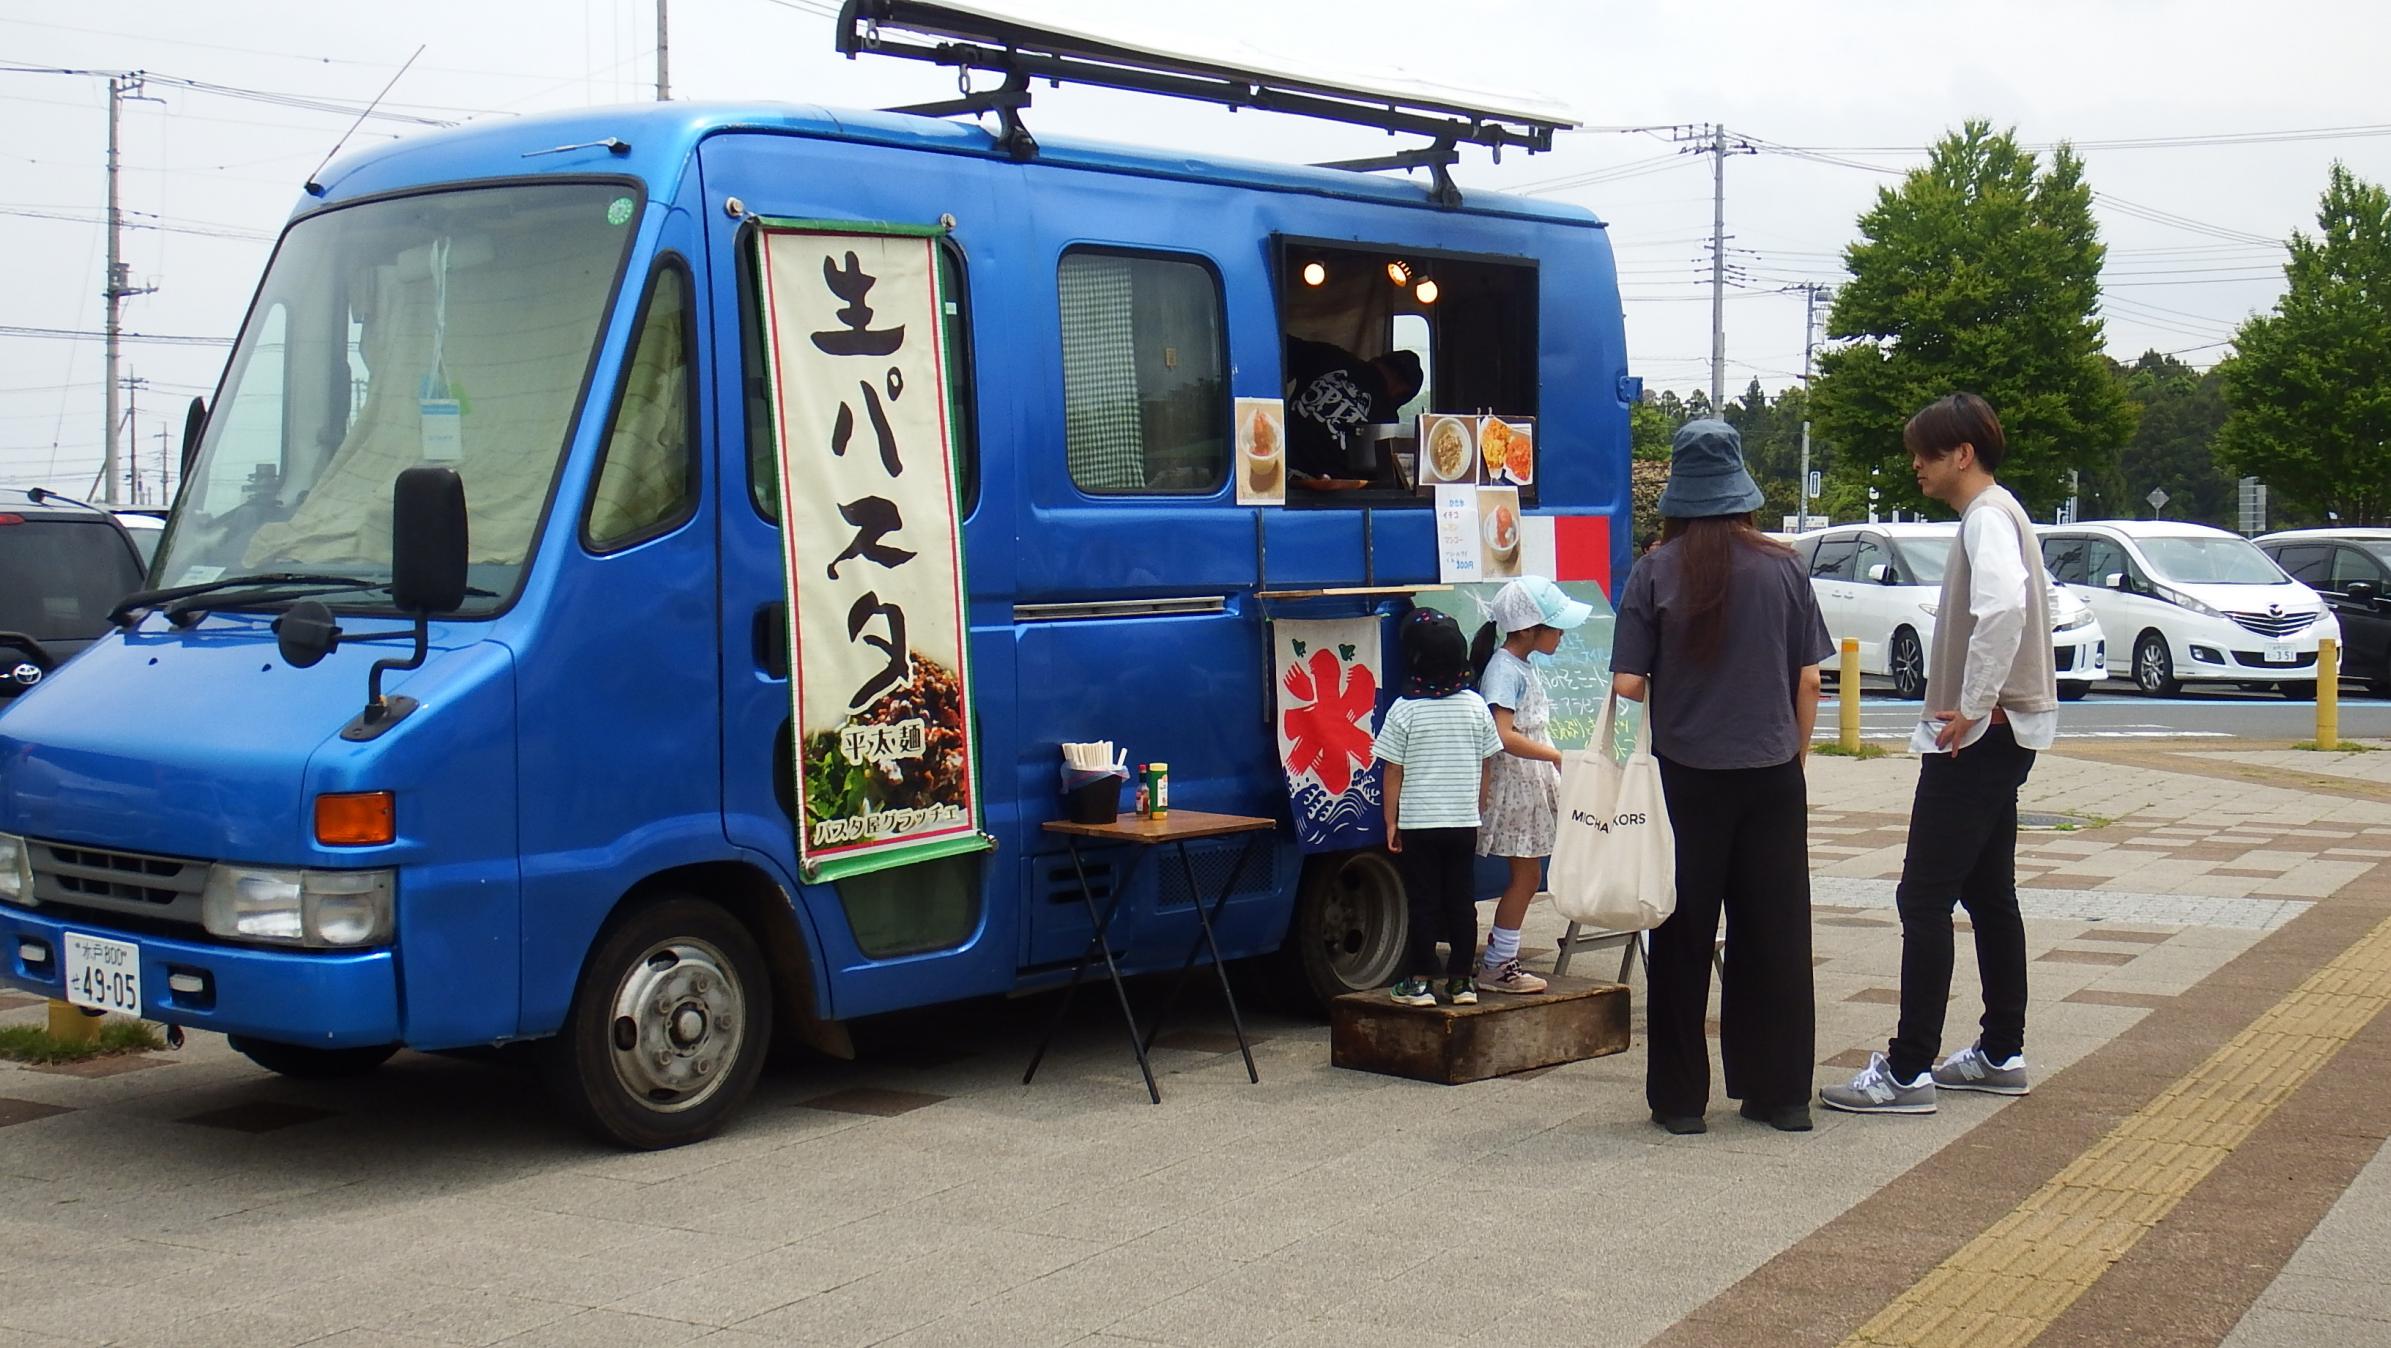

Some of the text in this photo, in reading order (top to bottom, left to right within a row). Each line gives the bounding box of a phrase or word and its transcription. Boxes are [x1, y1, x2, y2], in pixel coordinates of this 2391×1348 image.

[810, 250, 918, 710] 生パスタ
[844, 723, 922, 760] 平太麺
[816, 805, 959, 842] パスタ屋グラッチェ
[1571, 809, 1611, 834] MICHA
